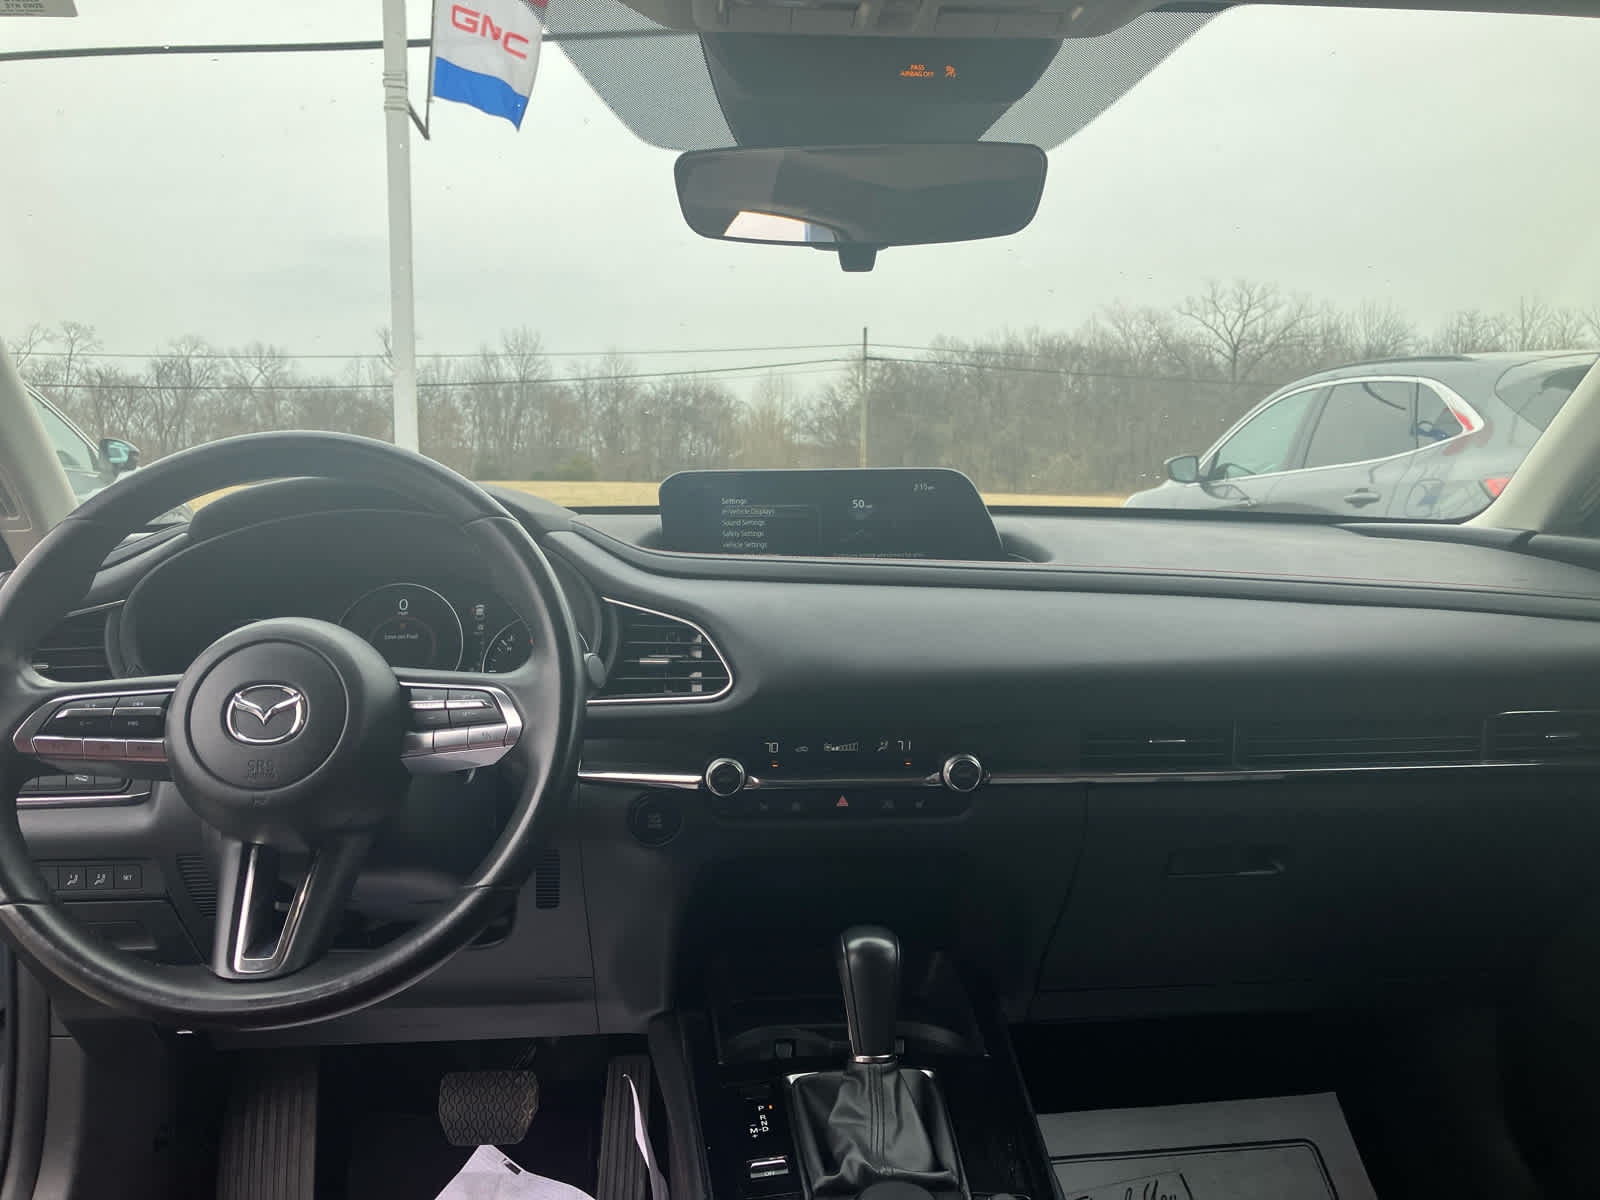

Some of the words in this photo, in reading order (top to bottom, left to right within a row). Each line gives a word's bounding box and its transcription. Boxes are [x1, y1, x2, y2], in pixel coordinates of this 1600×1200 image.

[721, 497, 747, 506] Settings
[852, 499, 865, 509] 50
[742, 519, 766, 527] Settings
[741, 530, 764, 538] Settings
[744, 541, 768, 549] Settings
[399, 598, 408, 611] 0
[764, 741, 779, 753] 70
[897, 740, 911, 752] 71
